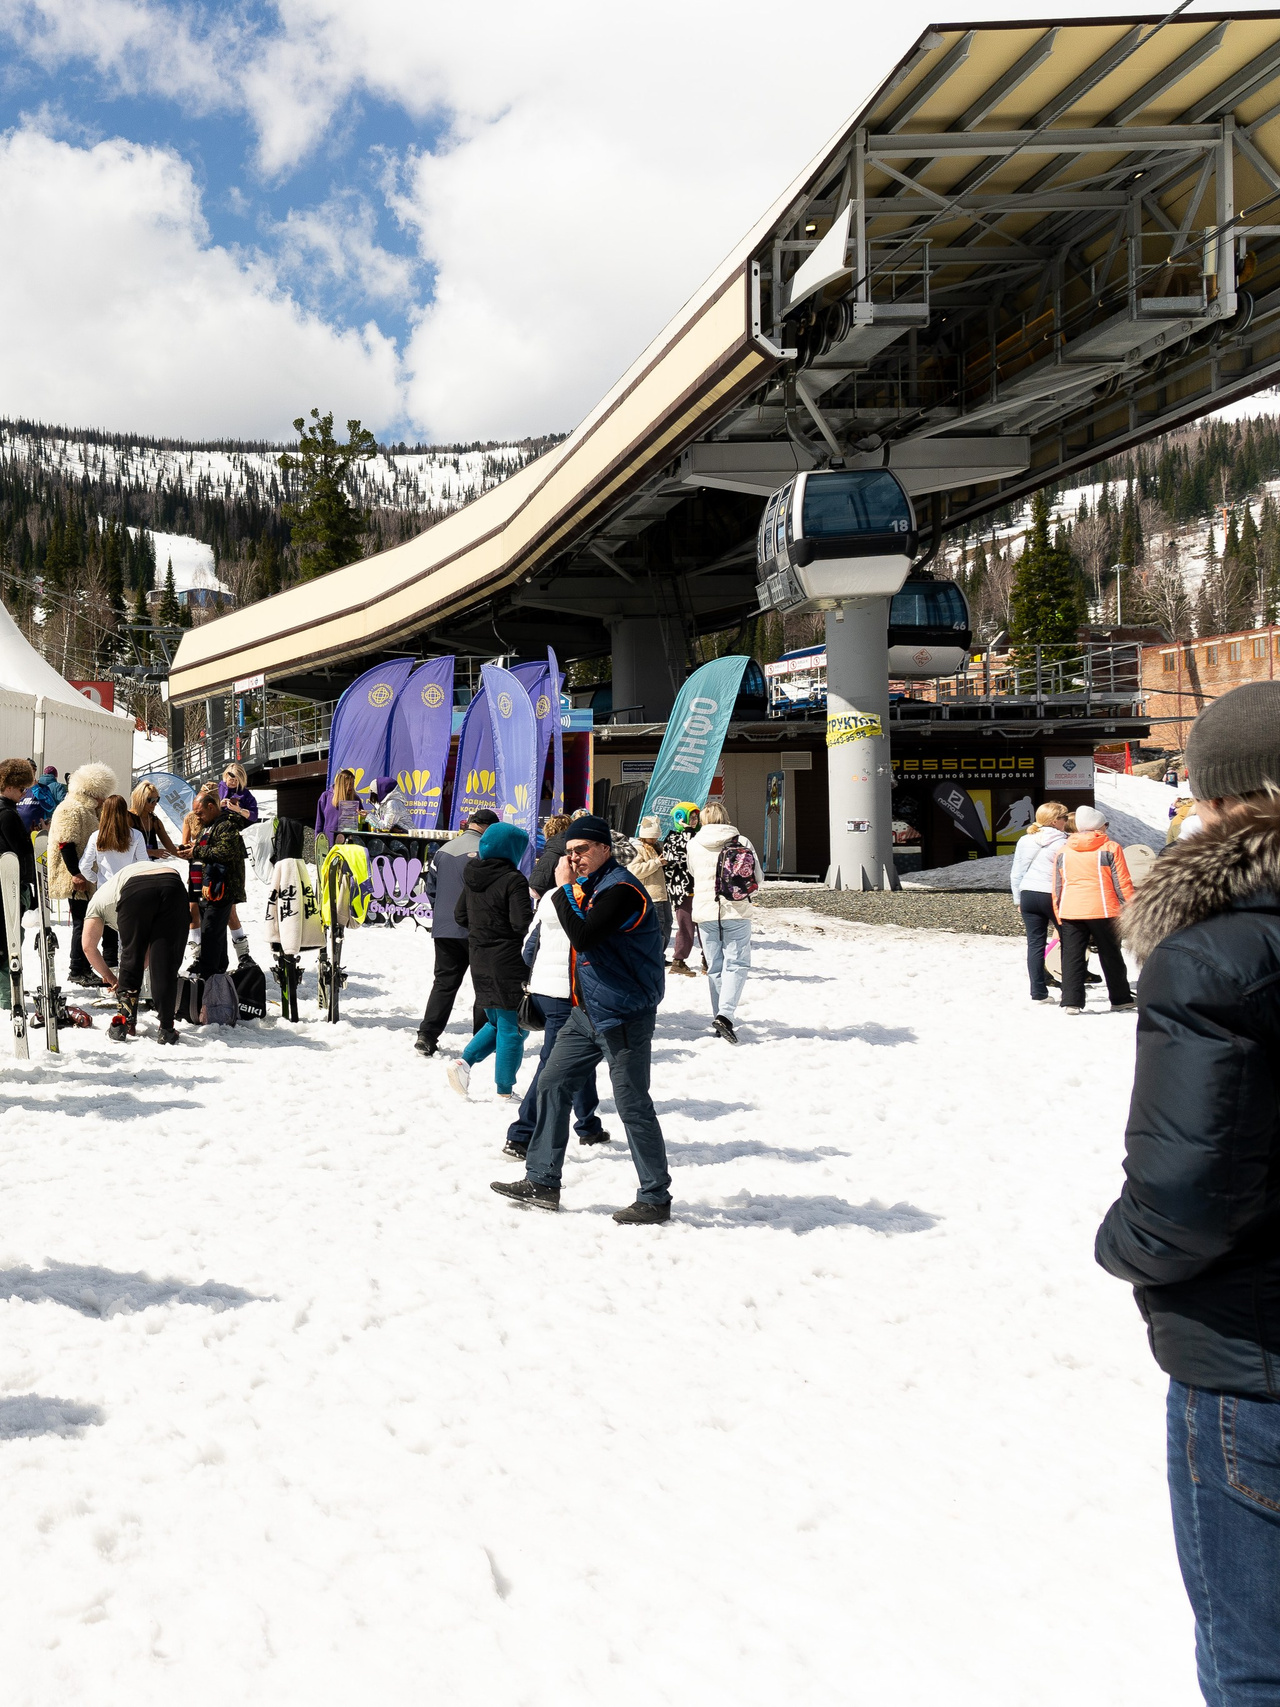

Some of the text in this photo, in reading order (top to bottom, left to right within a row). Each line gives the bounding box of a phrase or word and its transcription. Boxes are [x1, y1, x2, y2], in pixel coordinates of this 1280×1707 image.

[890, 520, 909, 532] 18
[953, 621, 966, 630] 46
[671, 697, 718, 774] ИНФО
[897, 772, 1035, 780] спортивной экипировки
[370, 900, 434, 919] бьюти-ба
